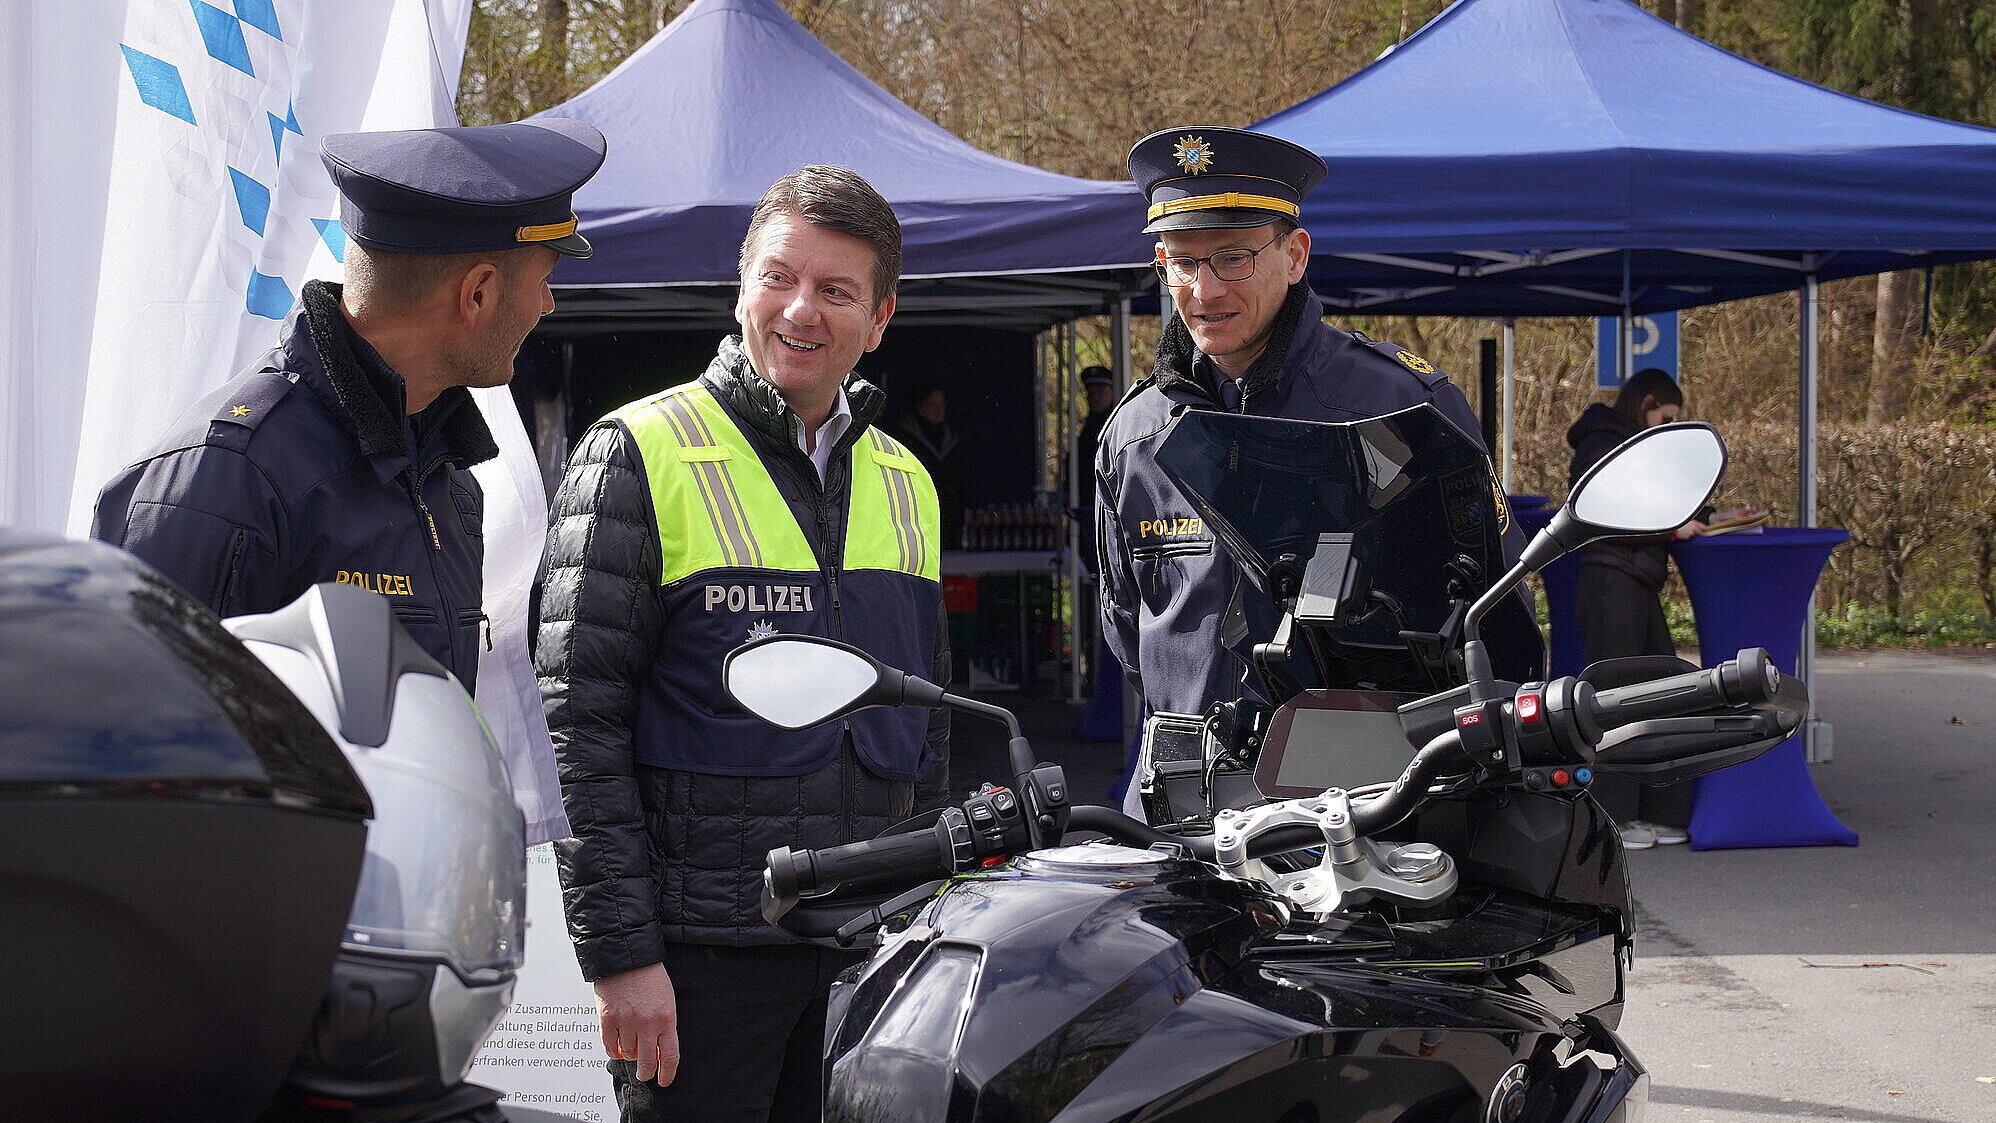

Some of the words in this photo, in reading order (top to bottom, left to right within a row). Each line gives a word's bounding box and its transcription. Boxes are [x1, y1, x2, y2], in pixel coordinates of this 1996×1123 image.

[1616, 316, 1660, 379] P
[1139, 517, 1203, 538] POLIZEI
[335, 570, 414, 596] POLIZEI
[705, 585, 814, 612] POLIZEI
[1463, 715, 1478, 724] SOS
[483, 1038, 504, 1048] und
[506, 1038, 536, 1049] diese
[538, 1040, 570, 1050] durch
[572, 1040, 593, 1050] das
[527, 1056, 585, 1068] verwendet
[514, 1092, 552, 1102] Person
[555, 1092, 606, 1105] und/oder
[583, 1110, 603, 1122] Sie,
